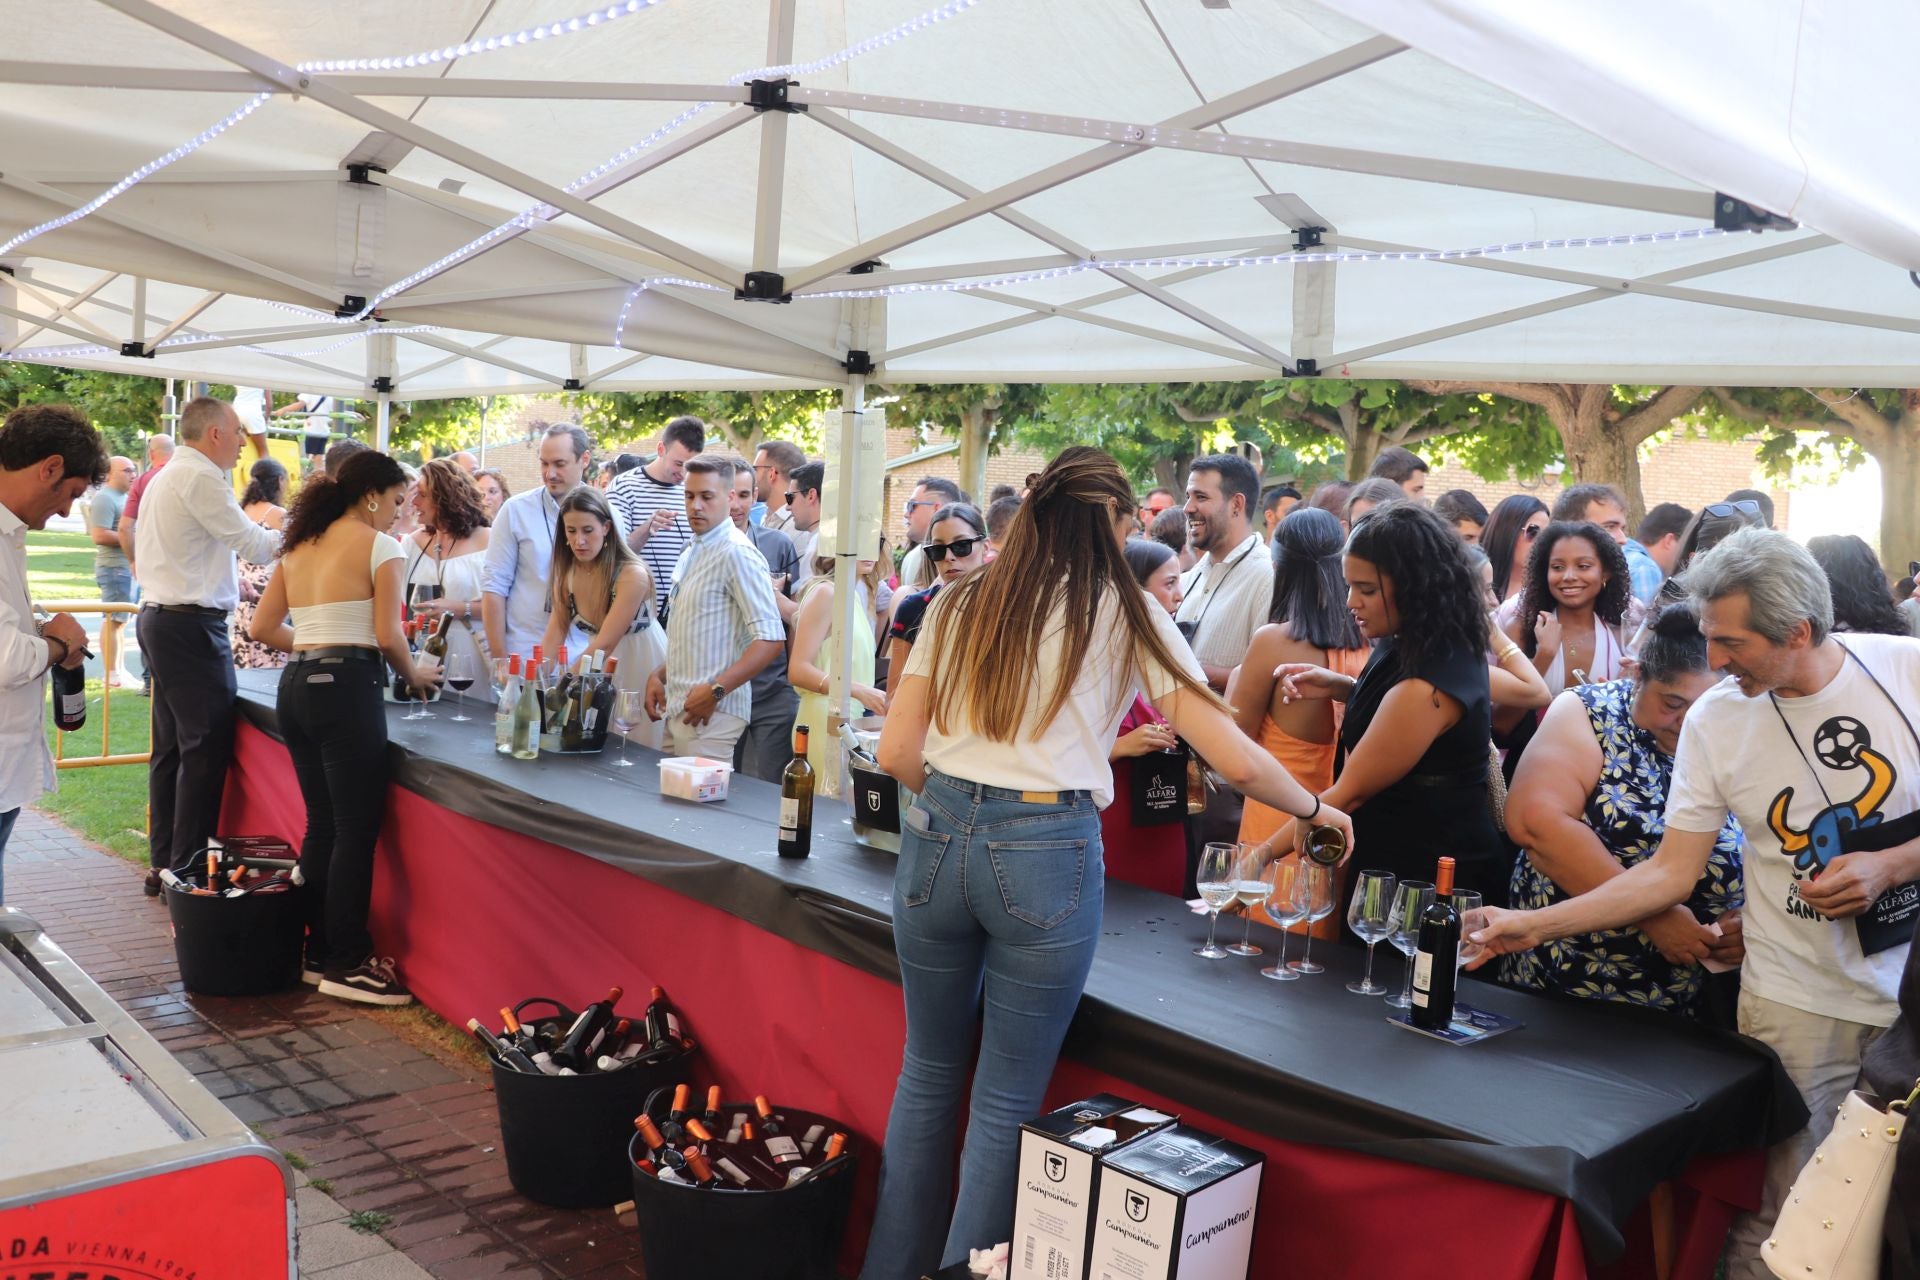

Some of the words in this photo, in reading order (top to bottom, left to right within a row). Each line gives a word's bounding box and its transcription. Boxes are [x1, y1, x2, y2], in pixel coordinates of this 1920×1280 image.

[1147, 787, 1177, 799] ALFARO
[1877, 889, 1917, 912] ALFARO
[0, 1236, 51, 1260] DA
[66, 1242, 147, 1264] VIENNA
[154, 1258, 197, 1280] 1904
